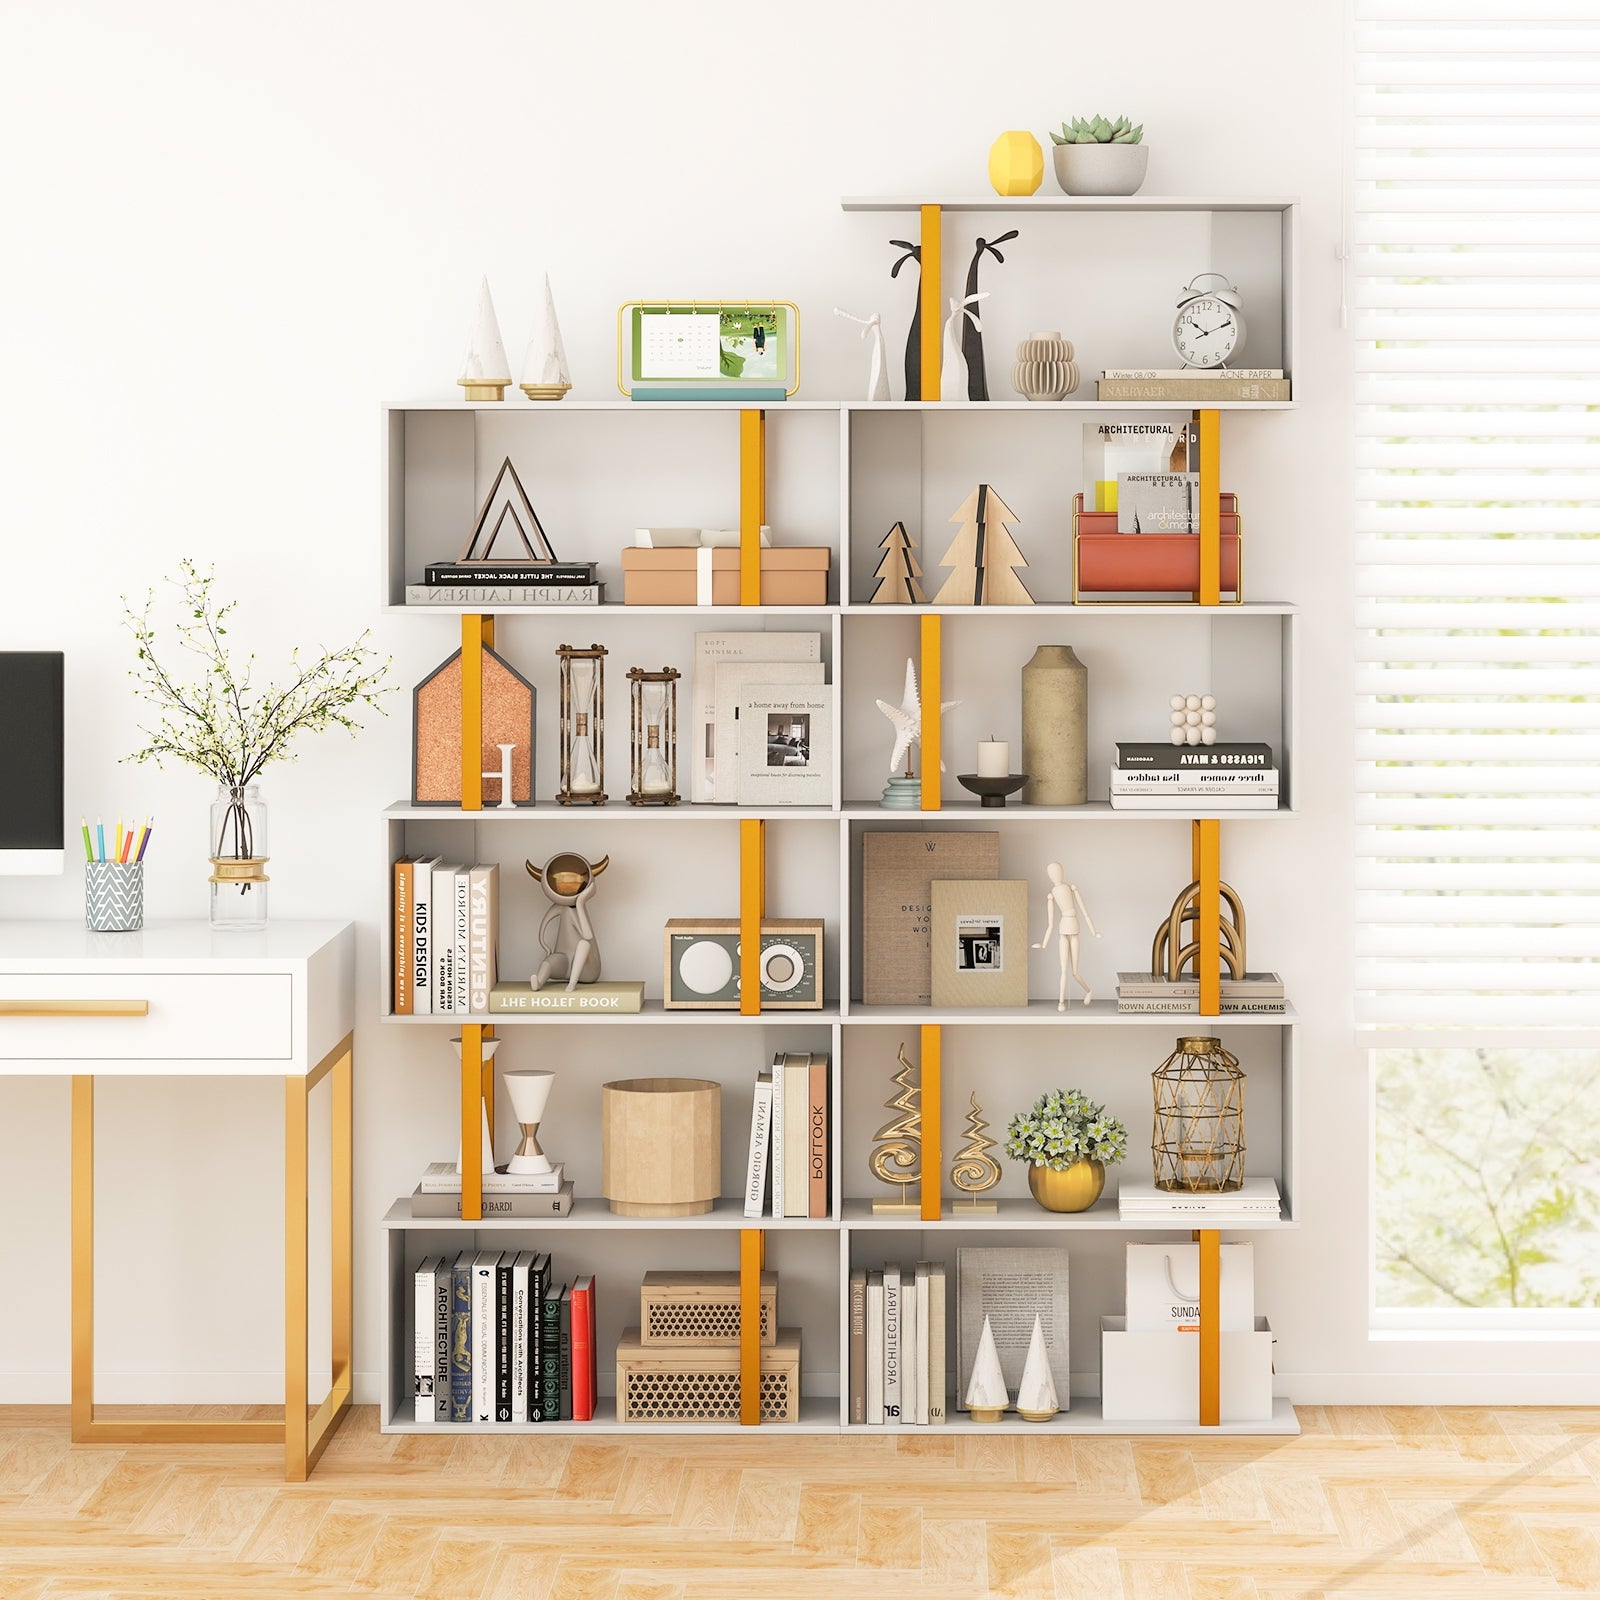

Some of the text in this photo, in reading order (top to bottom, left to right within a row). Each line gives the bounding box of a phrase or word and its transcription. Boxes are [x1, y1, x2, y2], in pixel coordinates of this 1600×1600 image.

[1191, 305, 1201, 314] 11
[1202, 302, 1213, 311] 12
[1216, 304, 1221, 313] 1
[1181, 316, 1192, 324] 10
[1226, 314, 1231, 322] 2
[1177, 328, 1182, 336] 9
[1230, 328, 1235, 336] 3
[1180, 342, 1186, 350] 8
[1224, 342, 1230, 350] 4
[1189, 351, 1195, 360] 7
[1202, 355, 1208, 364] 6
[1215, 352, 1220, 361] 5
[1220, 370, 1272, 379] ACNE PAPER
[1098, 425, 1173, 434] ARCHITECTURAL
[1148, 506, 1200, 520] architectur
[1158, 513, 1200, 529] &mone
[399, 872, 407, 913] simplicity
[399, 925, 406, 933] in
[416, 903, 427, 987] KIDS DESIGN
[398, 935, 406, 977] everything
[399, 979, 406, 989] we
[489, 1202, 512, 1211] BARDI
[1171, 1306, 1200, 1317] SUNDA
[438, 1286, 448, 1382] ARCHITECTURE
